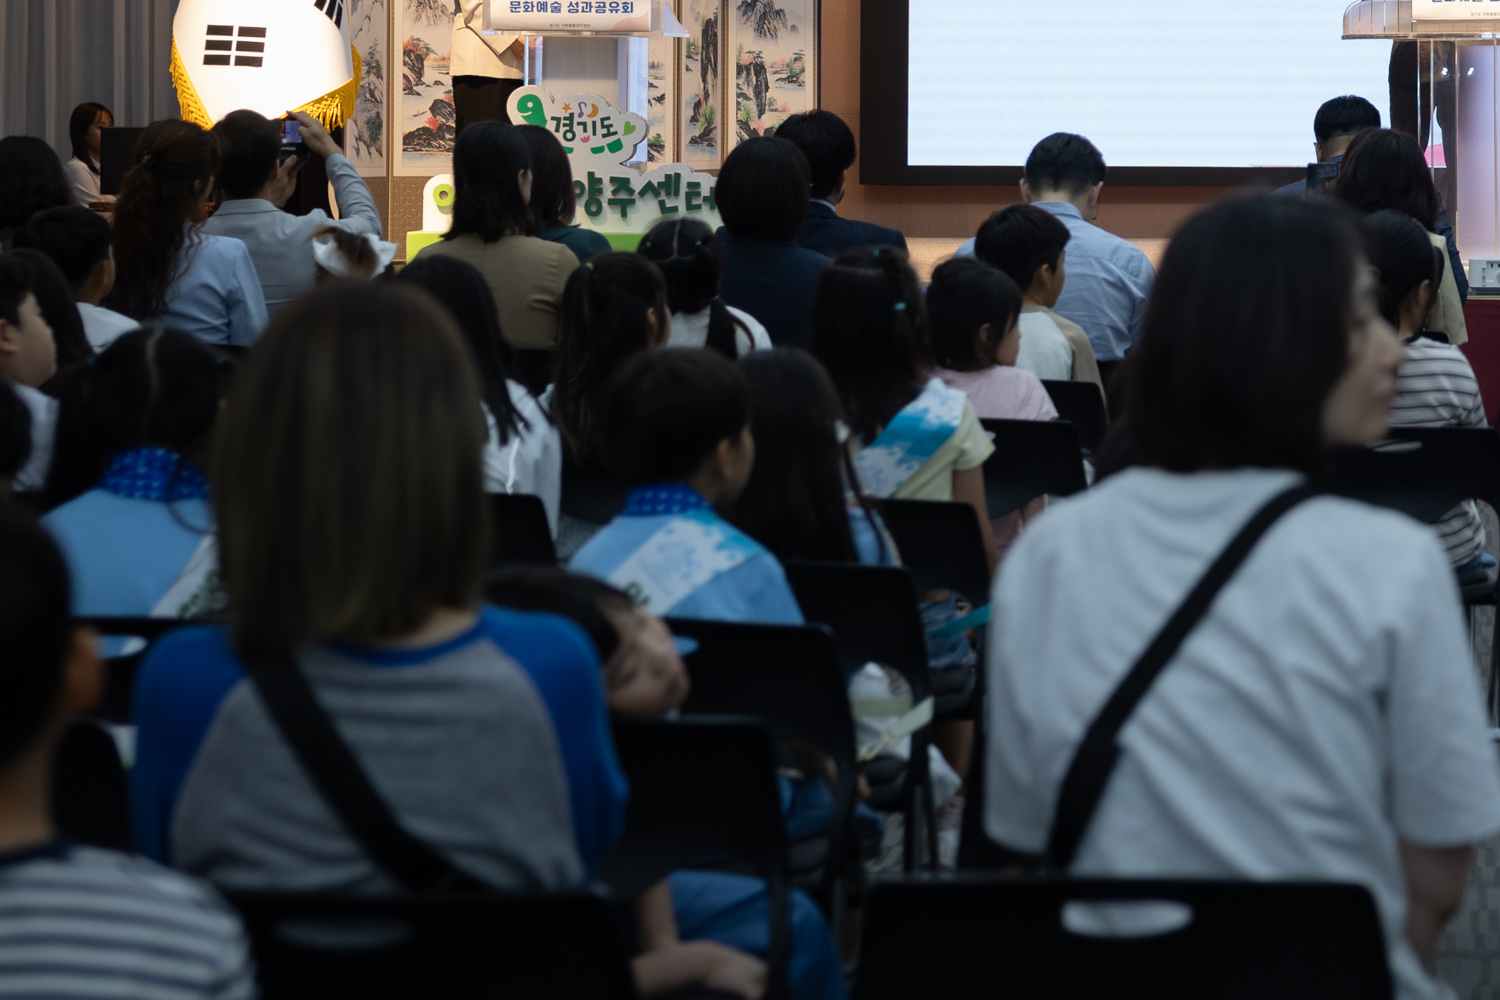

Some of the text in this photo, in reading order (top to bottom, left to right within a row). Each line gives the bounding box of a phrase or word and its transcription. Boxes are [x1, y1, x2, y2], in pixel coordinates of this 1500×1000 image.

[509, 0, 634, 14] 문화예술 성과공유회
[550, 112, 619, 142] 경기도
